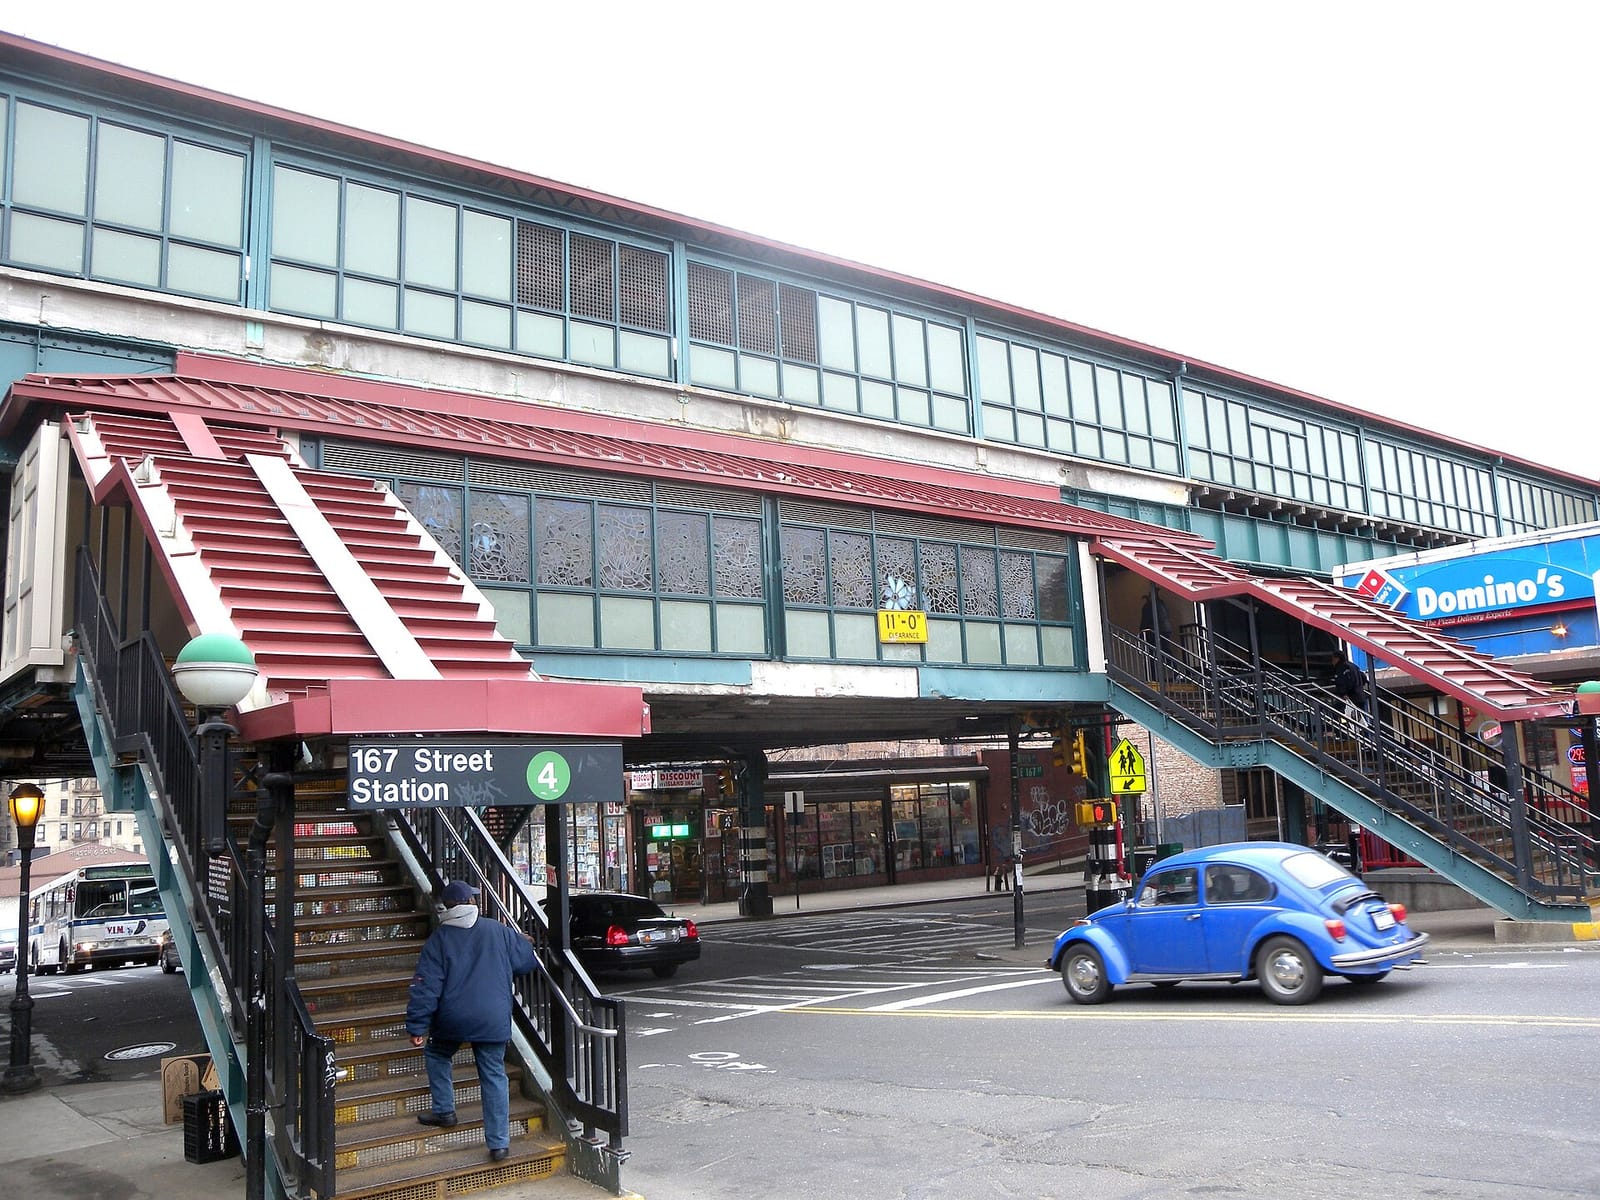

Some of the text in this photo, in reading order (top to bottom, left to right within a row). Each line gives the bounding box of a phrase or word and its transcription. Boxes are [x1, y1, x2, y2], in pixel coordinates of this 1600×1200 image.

[1416, 567, 1565, 616] Domino's
[1438, 617, 1456, 626] Pizza
[1457, 613, 1485, 624] Delivery
[1485, 610, 1512, 620] Experts
[889, 631, 920, 639] CLEARANCE
[351, 748, 494, 773] 167 Street
[537, 762, 558, 789] 4
[660, 773, 700, 781] DISCOUNT
[352, 778, 449, 803] Station
